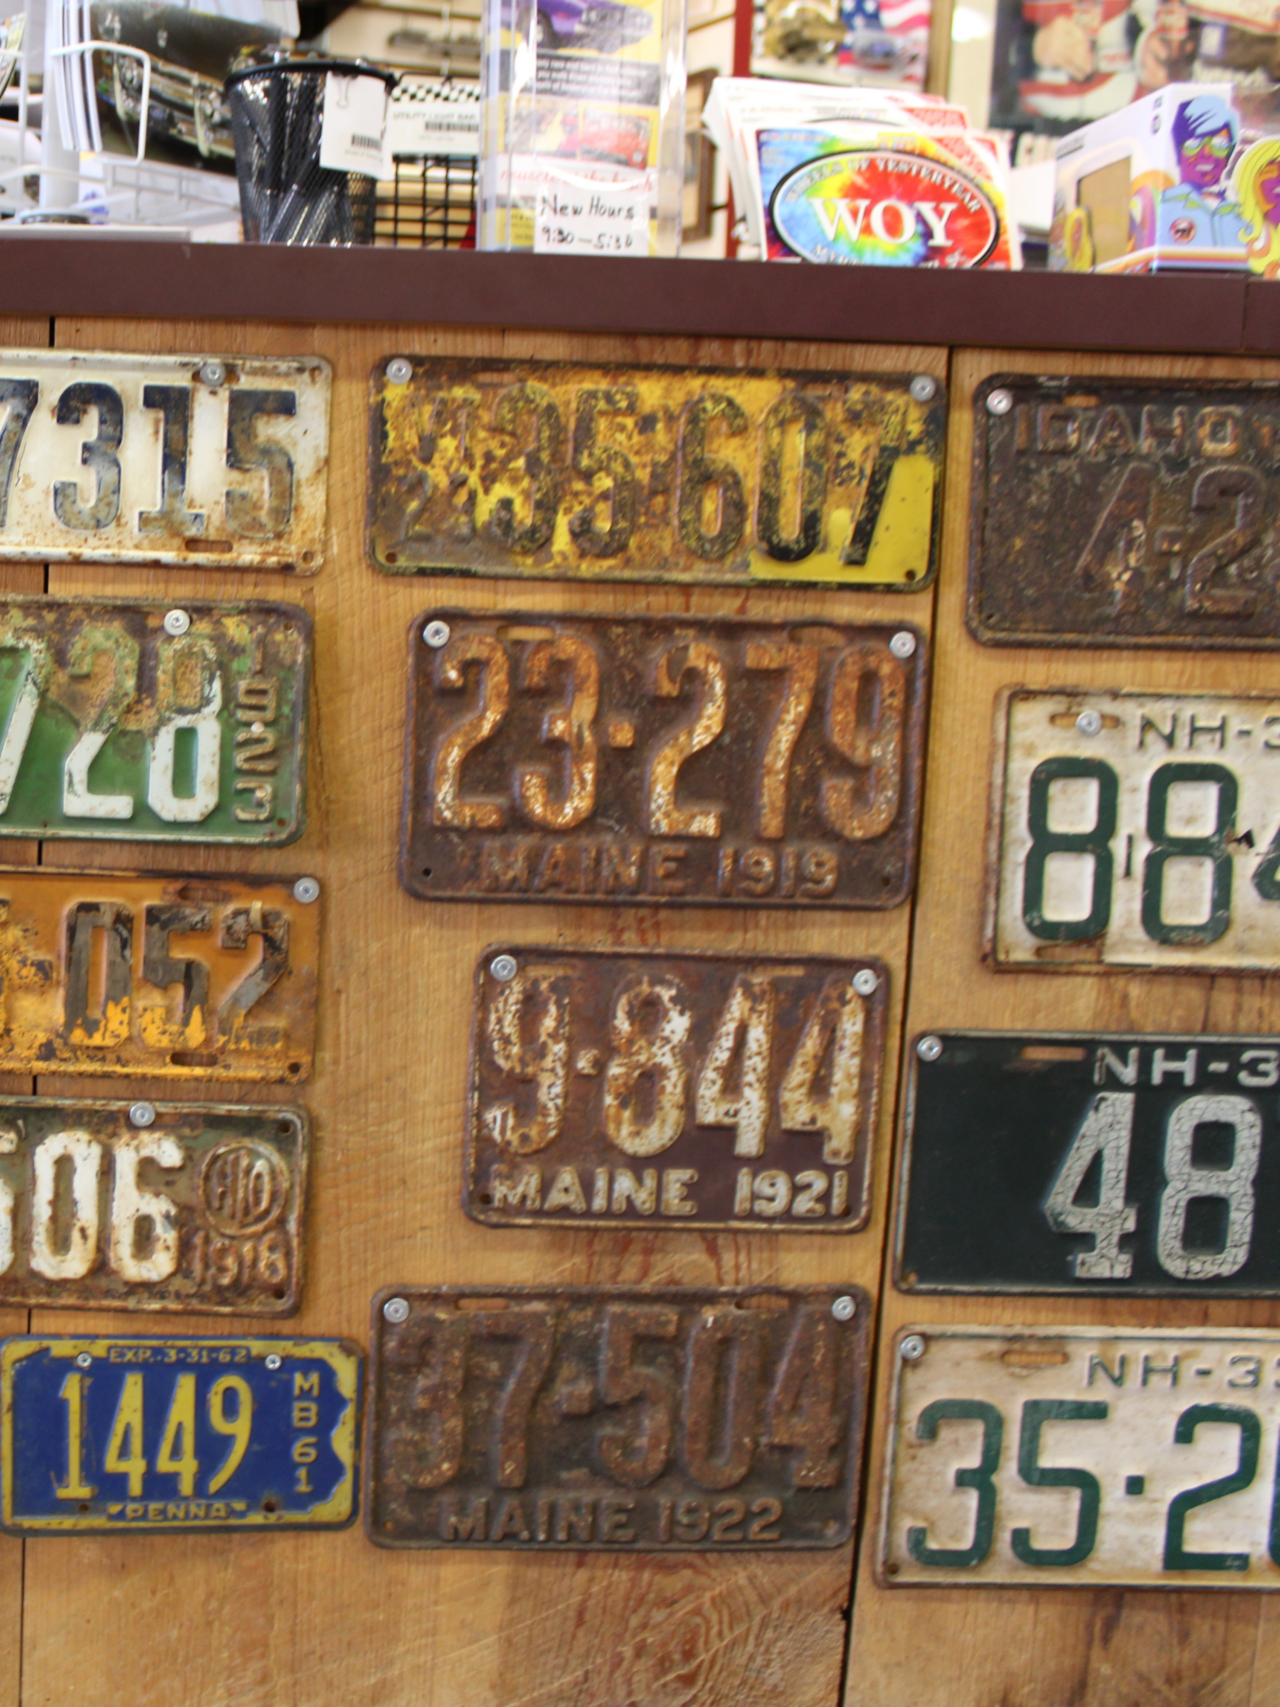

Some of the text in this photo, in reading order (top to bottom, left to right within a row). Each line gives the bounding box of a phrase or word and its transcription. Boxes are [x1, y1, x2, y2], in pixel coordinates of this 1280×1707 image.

[540, 193, 636, 219] New Hours
[809, 197, 959, 247] WOY
[1014, 404, 1243, 458] IDAHO
[480, 845, 839, 898] MAINE 1919
[489, 1164, 850, 1218] MAINE 1921
[1042, 1091, 1262, 1280] 48
[1087, 1353, 1279, 1388] NH-3
[56, 1371, 253, 1500] 1449
[125, 1502, 230, 1522] PENNA
[440, 1498, 783, 1543] MAINE 1922
